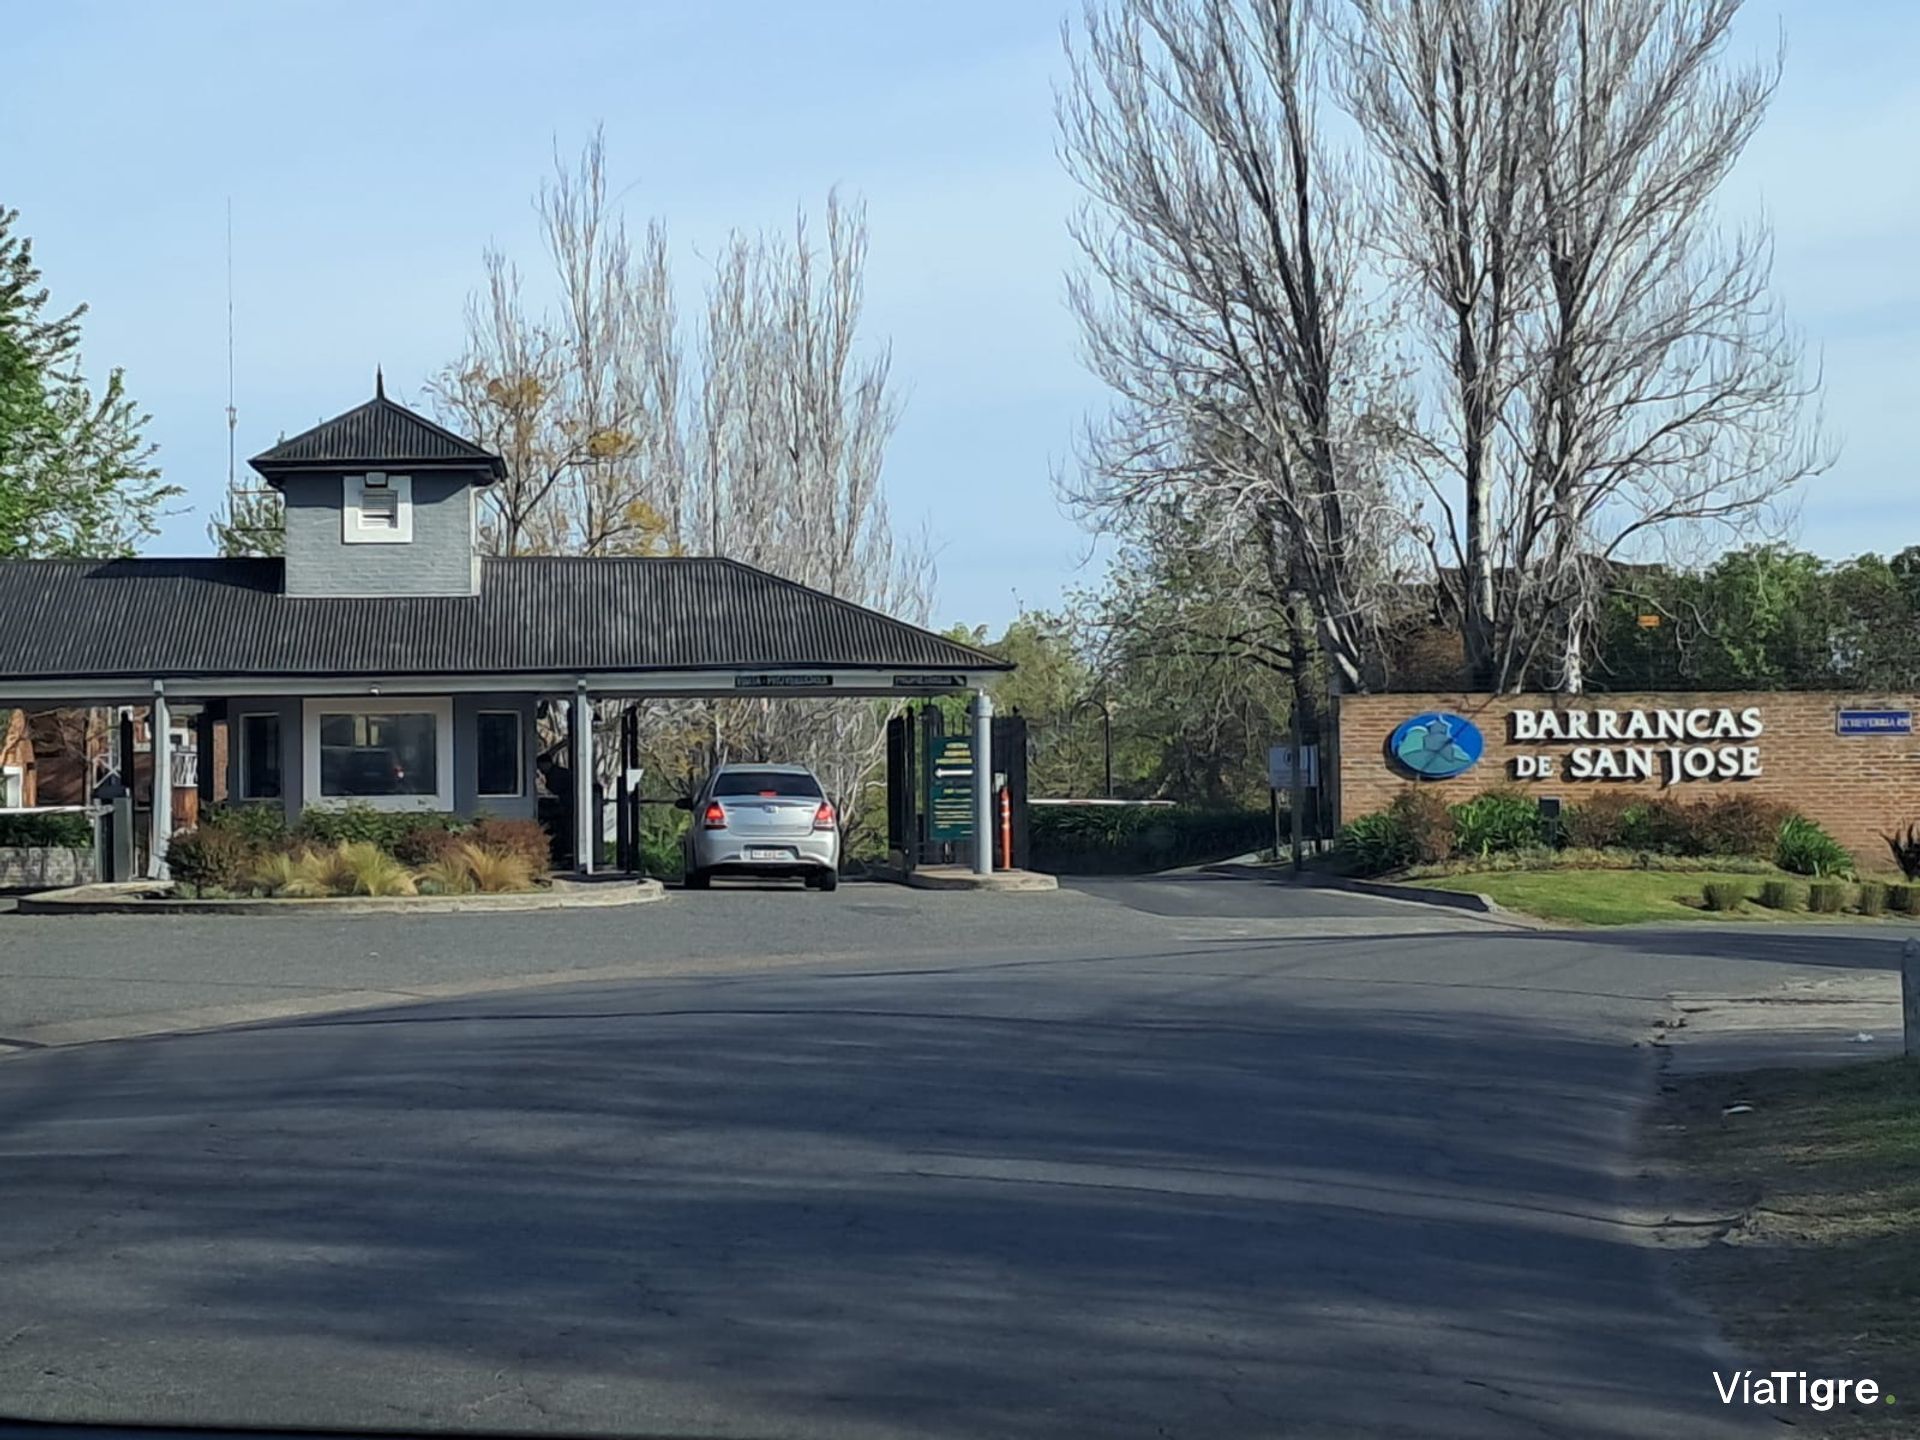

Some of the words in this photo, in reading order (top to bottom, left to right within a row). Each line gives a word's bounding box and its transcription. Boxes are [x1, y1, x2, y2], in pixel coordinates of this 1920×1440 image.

[1513, 708, 1763, 740] BARRANCAS
[1516, 756, 1554, 777] DE
[1570, 747, 1653, 778] SAN
[1667, 746, 1763, 785] JOSE
